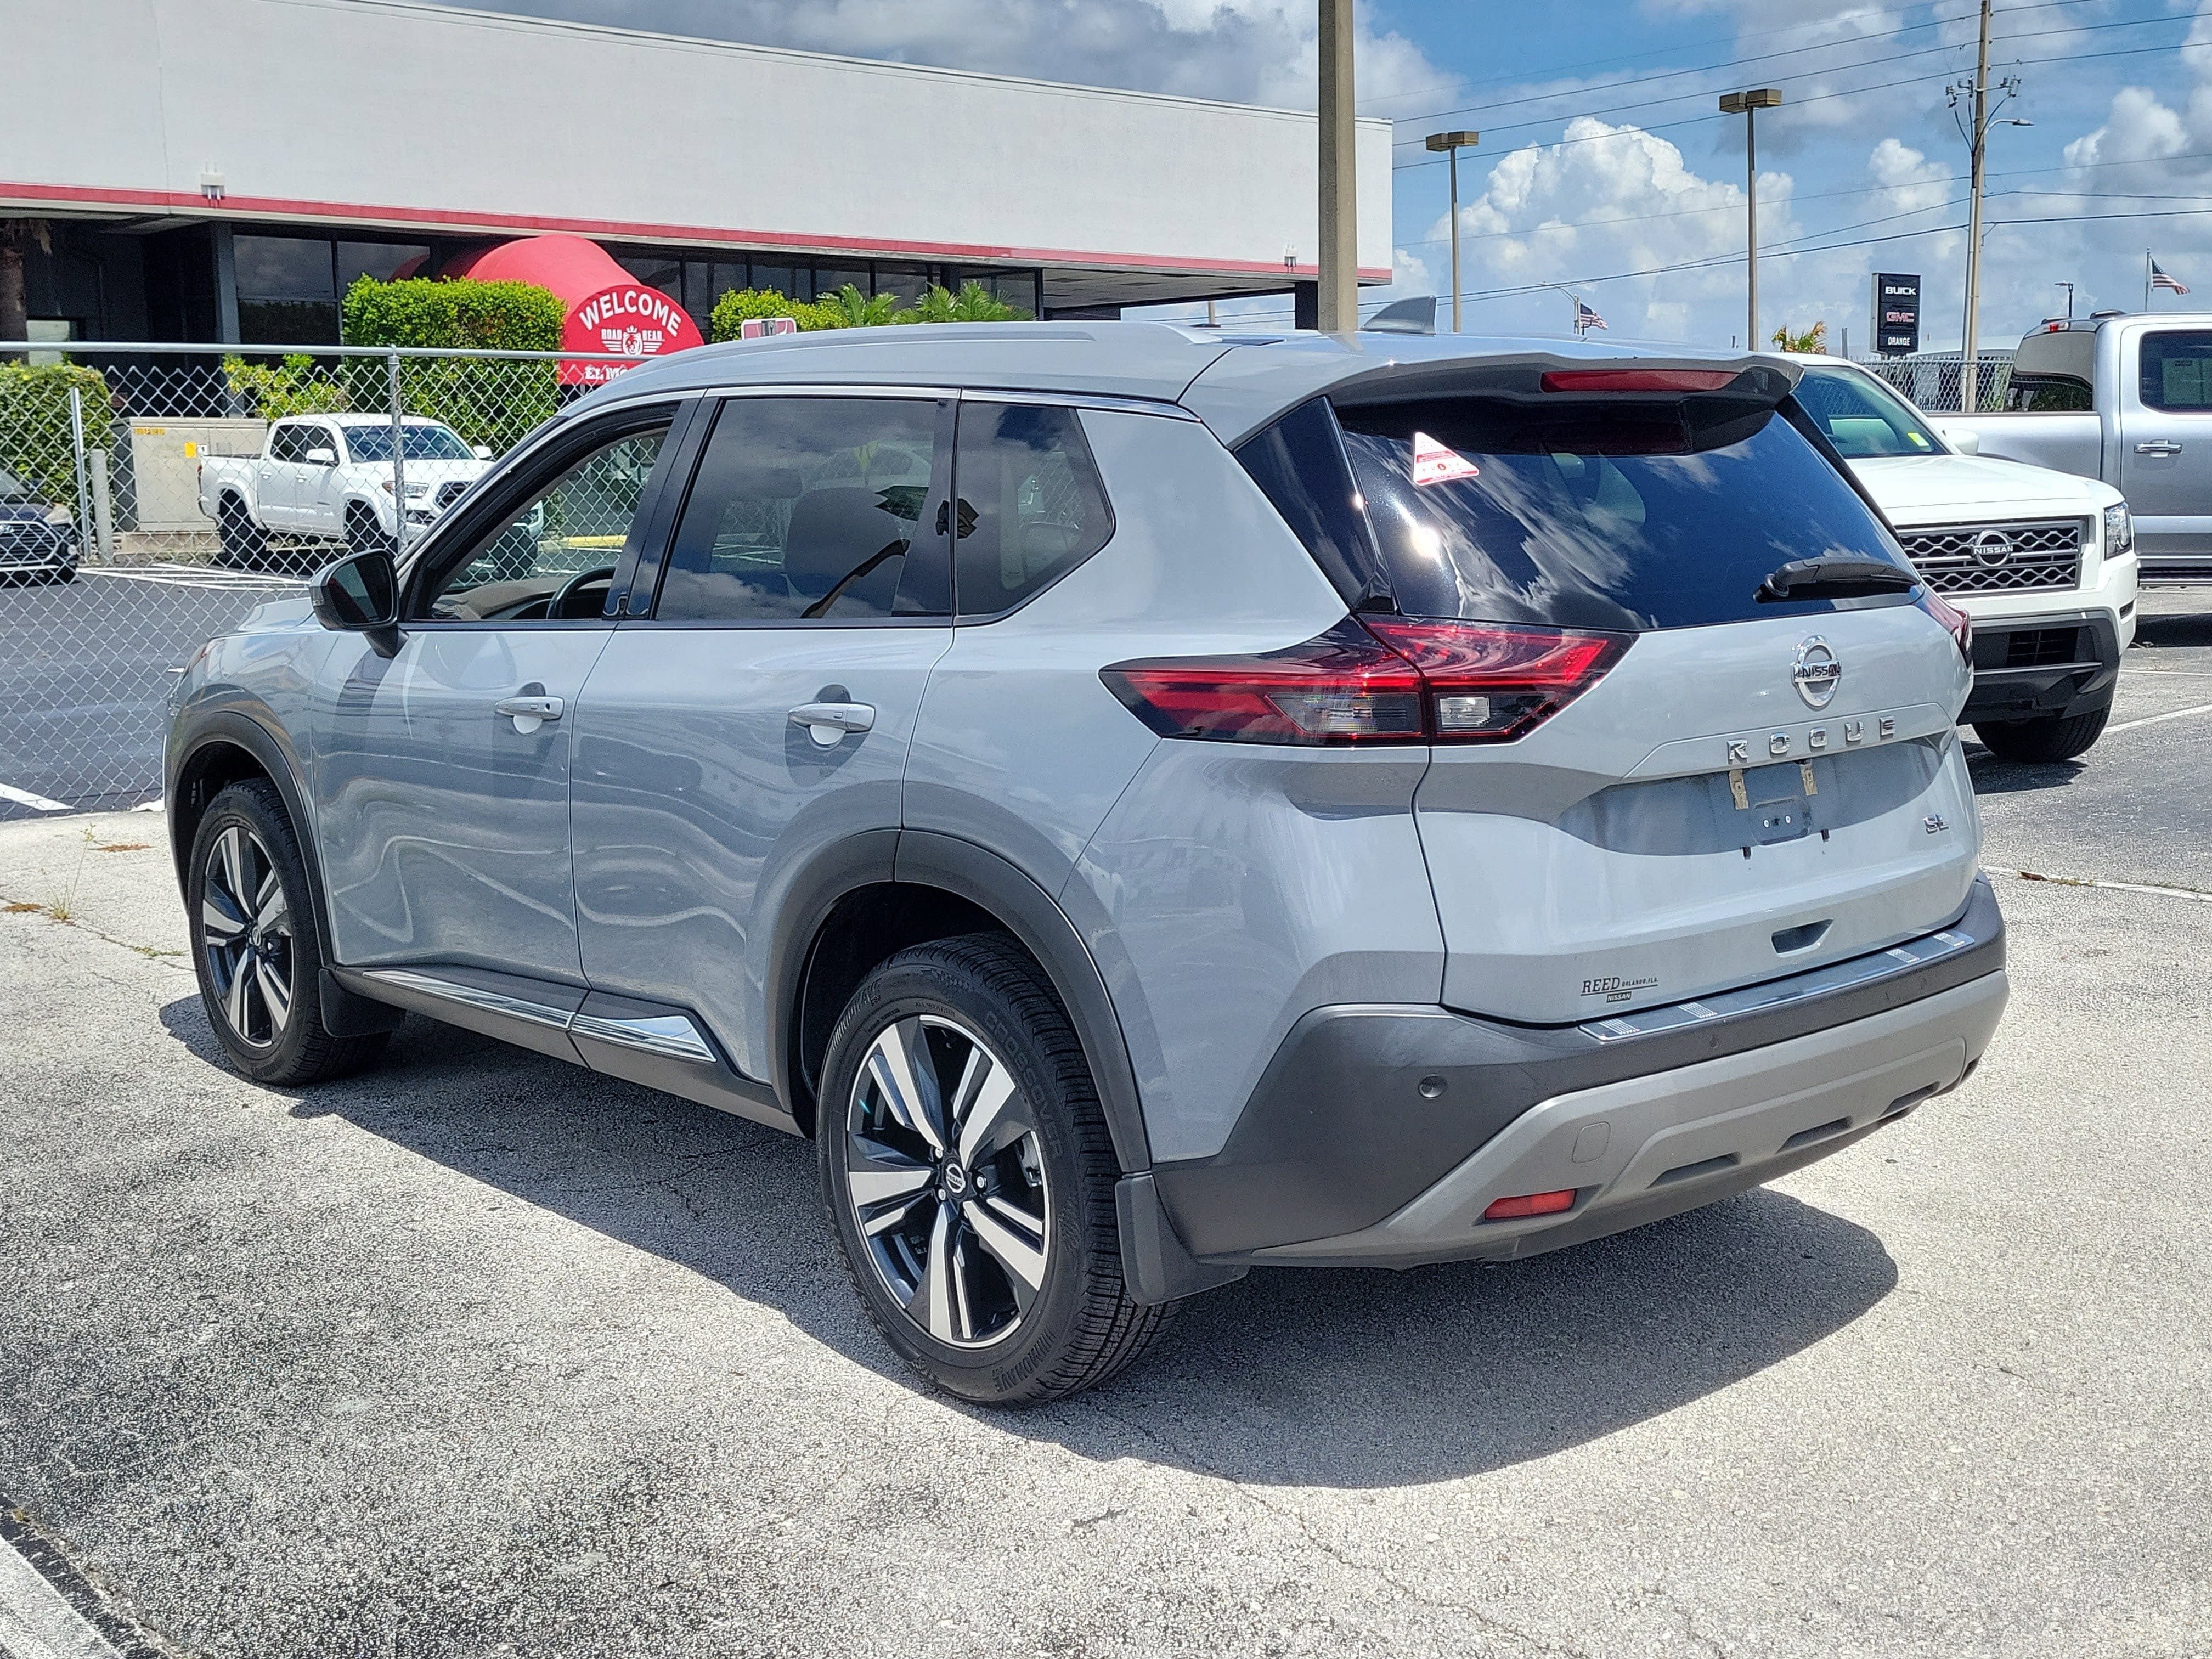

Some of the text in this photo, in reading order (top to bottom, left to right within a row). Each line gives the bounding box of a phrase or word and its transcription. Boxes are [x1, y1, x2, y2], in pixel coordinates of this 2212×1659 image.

[1884, 286, 1917, 295] BUICK
[579, 290, 682, 337] WELCOME
[1886, 312, 1915, 323] GMC
[601, 329, 622, 340] ROAD
[1888, 336, 1911, 346] ORANGE
[585, 366, 604, 380] EL
[1974, 546, 2013, 554] NISSAN
[1802, 663, 1841, 677] NISSAN
[1726, 715, 1895, 761] ROGUE
[1923, 814, 1950, 834] SL
[1582, 977, 1621, 994] REED
